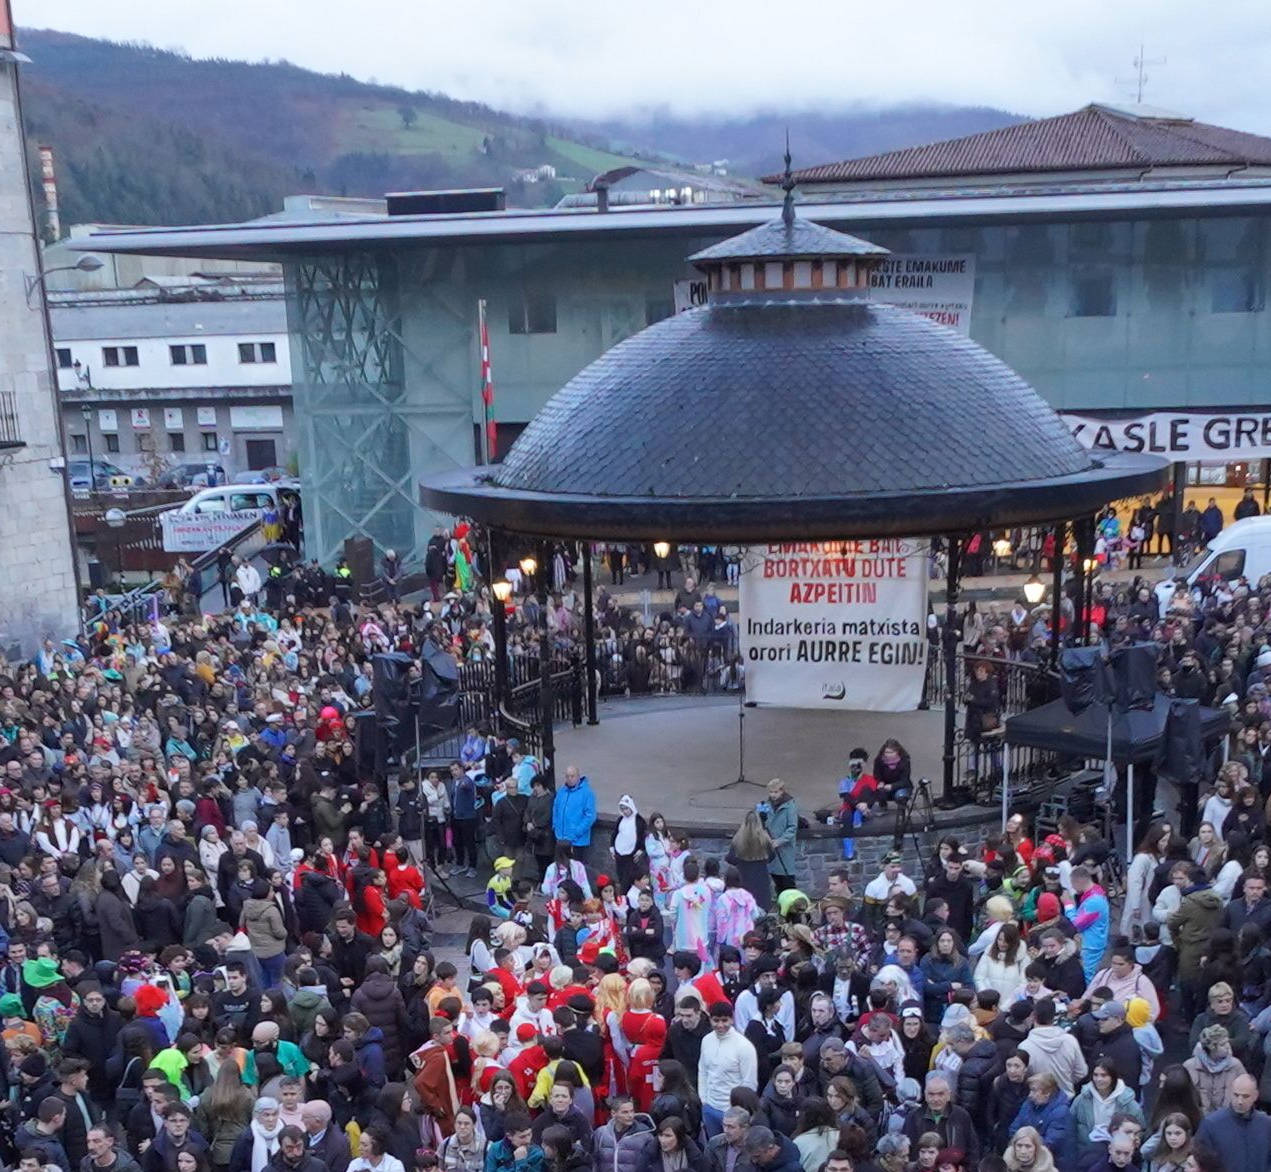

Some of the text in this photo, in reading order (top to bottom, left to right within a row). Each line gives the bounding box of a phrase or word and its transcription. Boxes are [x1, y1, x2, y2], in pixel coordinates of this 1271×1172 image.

[906, 260, 966, 273] EMAKUME
[871, 275, 933, 288] BAT ERAILA
[763, 558, 907, 578] BORTXATU DUTE
[790, 582, 877, 604] AZPEITIN
[747, 617, 920, 636] Indarkeria matxista
[749, 640, 924, 665] orori AURRE EGIN!
